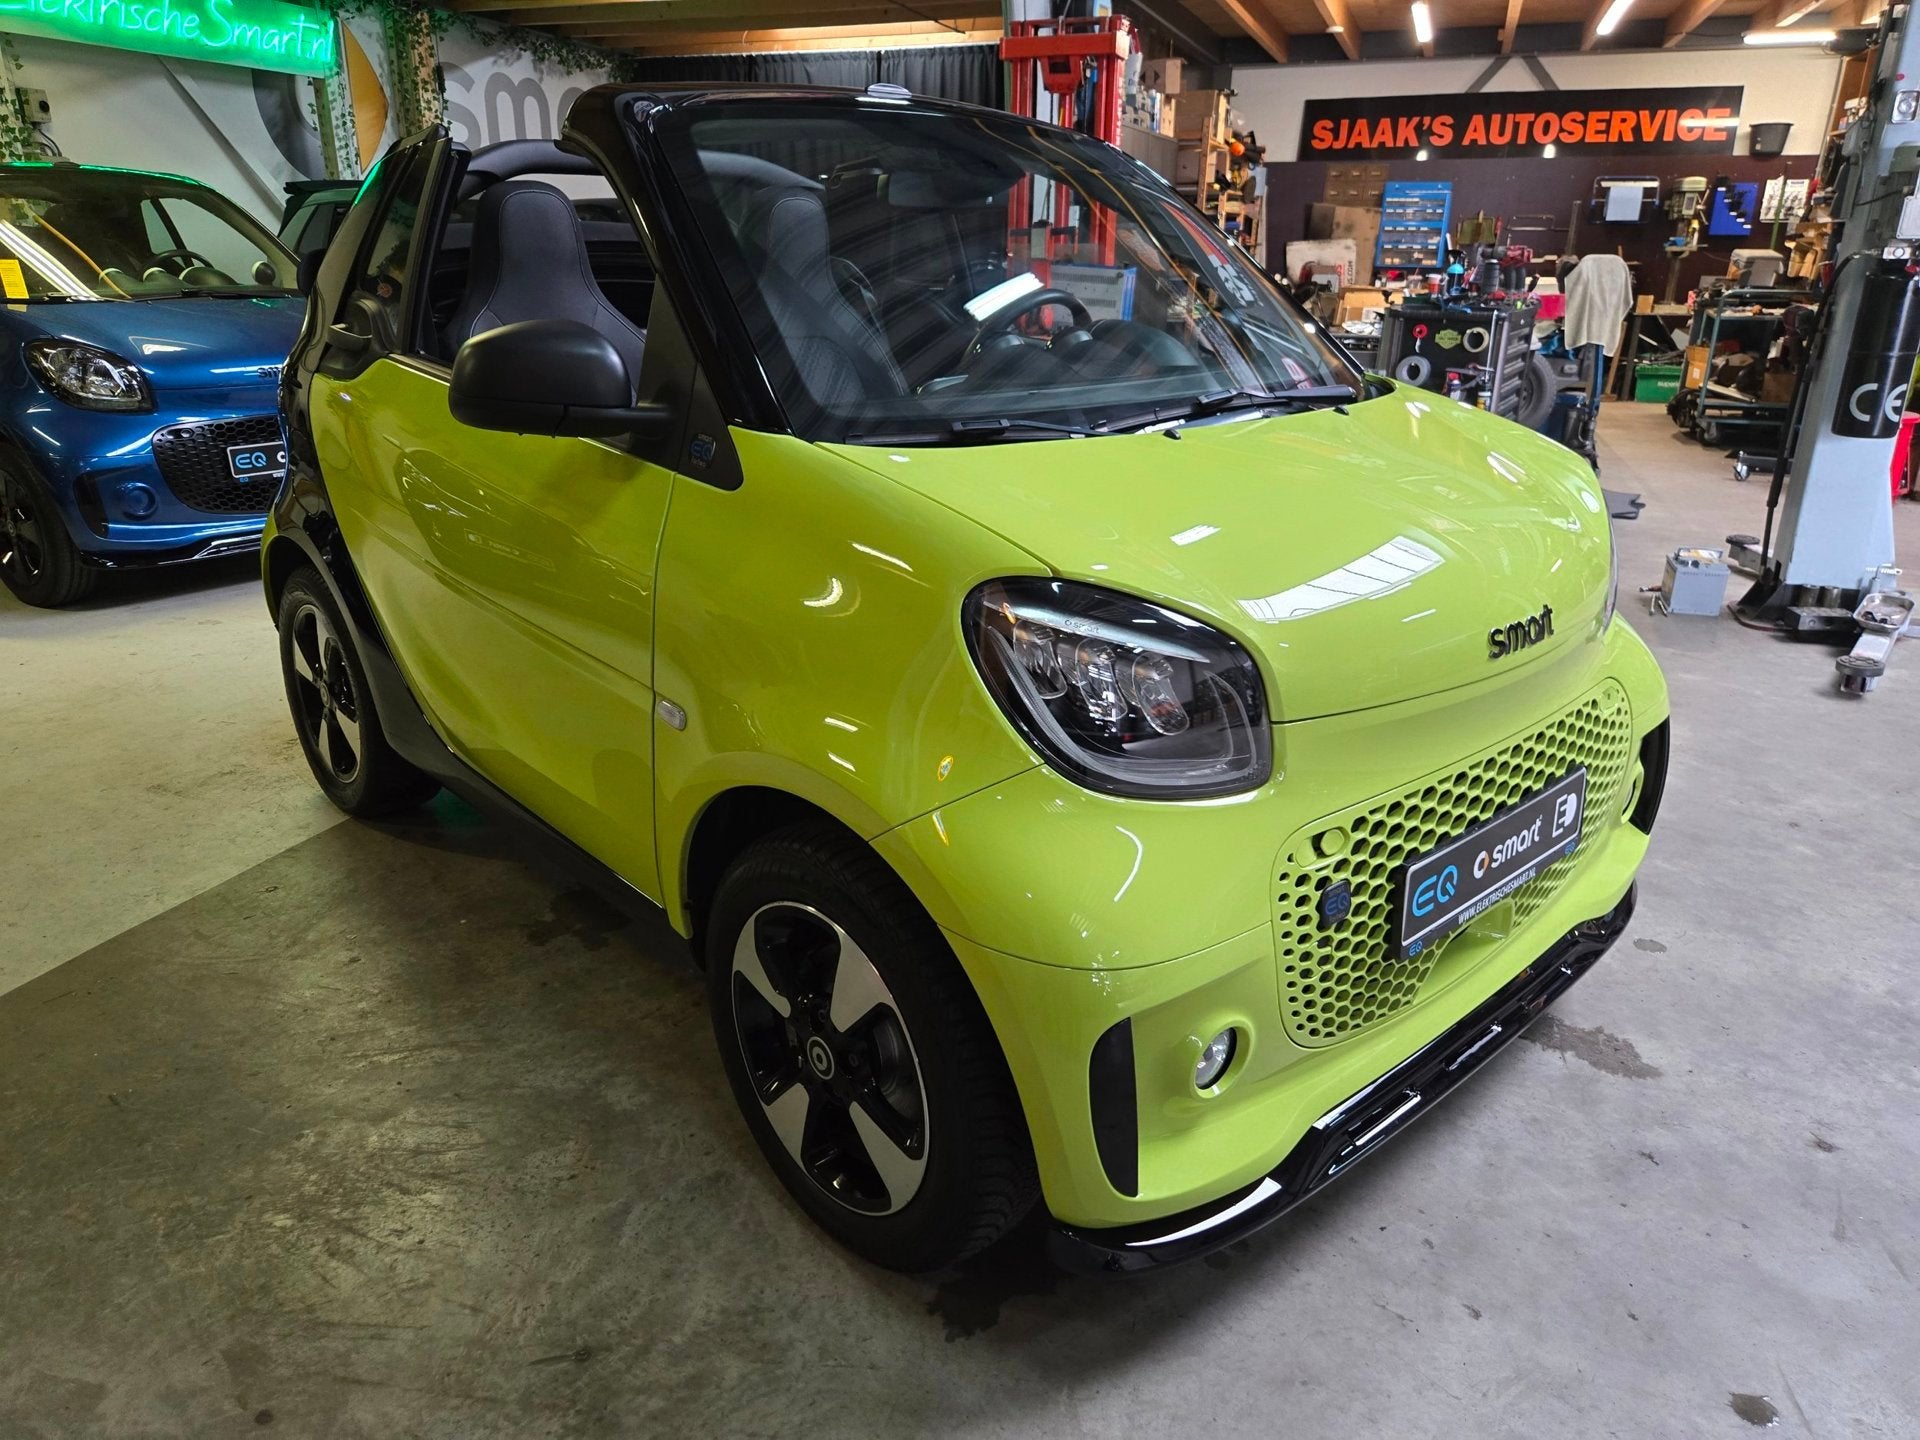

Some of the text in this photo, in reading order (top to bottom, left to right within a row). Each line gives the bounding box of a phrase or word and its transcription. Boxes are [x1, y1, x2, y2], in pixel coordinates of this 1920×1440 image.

[0, 0, 334, 62] ekrischeSmart.nl
[1311, 108, 1731, 150] SJAAK'S AUTOSERVICE
[235, 451, 267, 469] EQ
[1488, 603, 1555, 659] smart
[1411, 864, 1458, 917] EQ
[1490, 818, 1541, 868] smart
[1325, 892, 1349, 915] EQ
